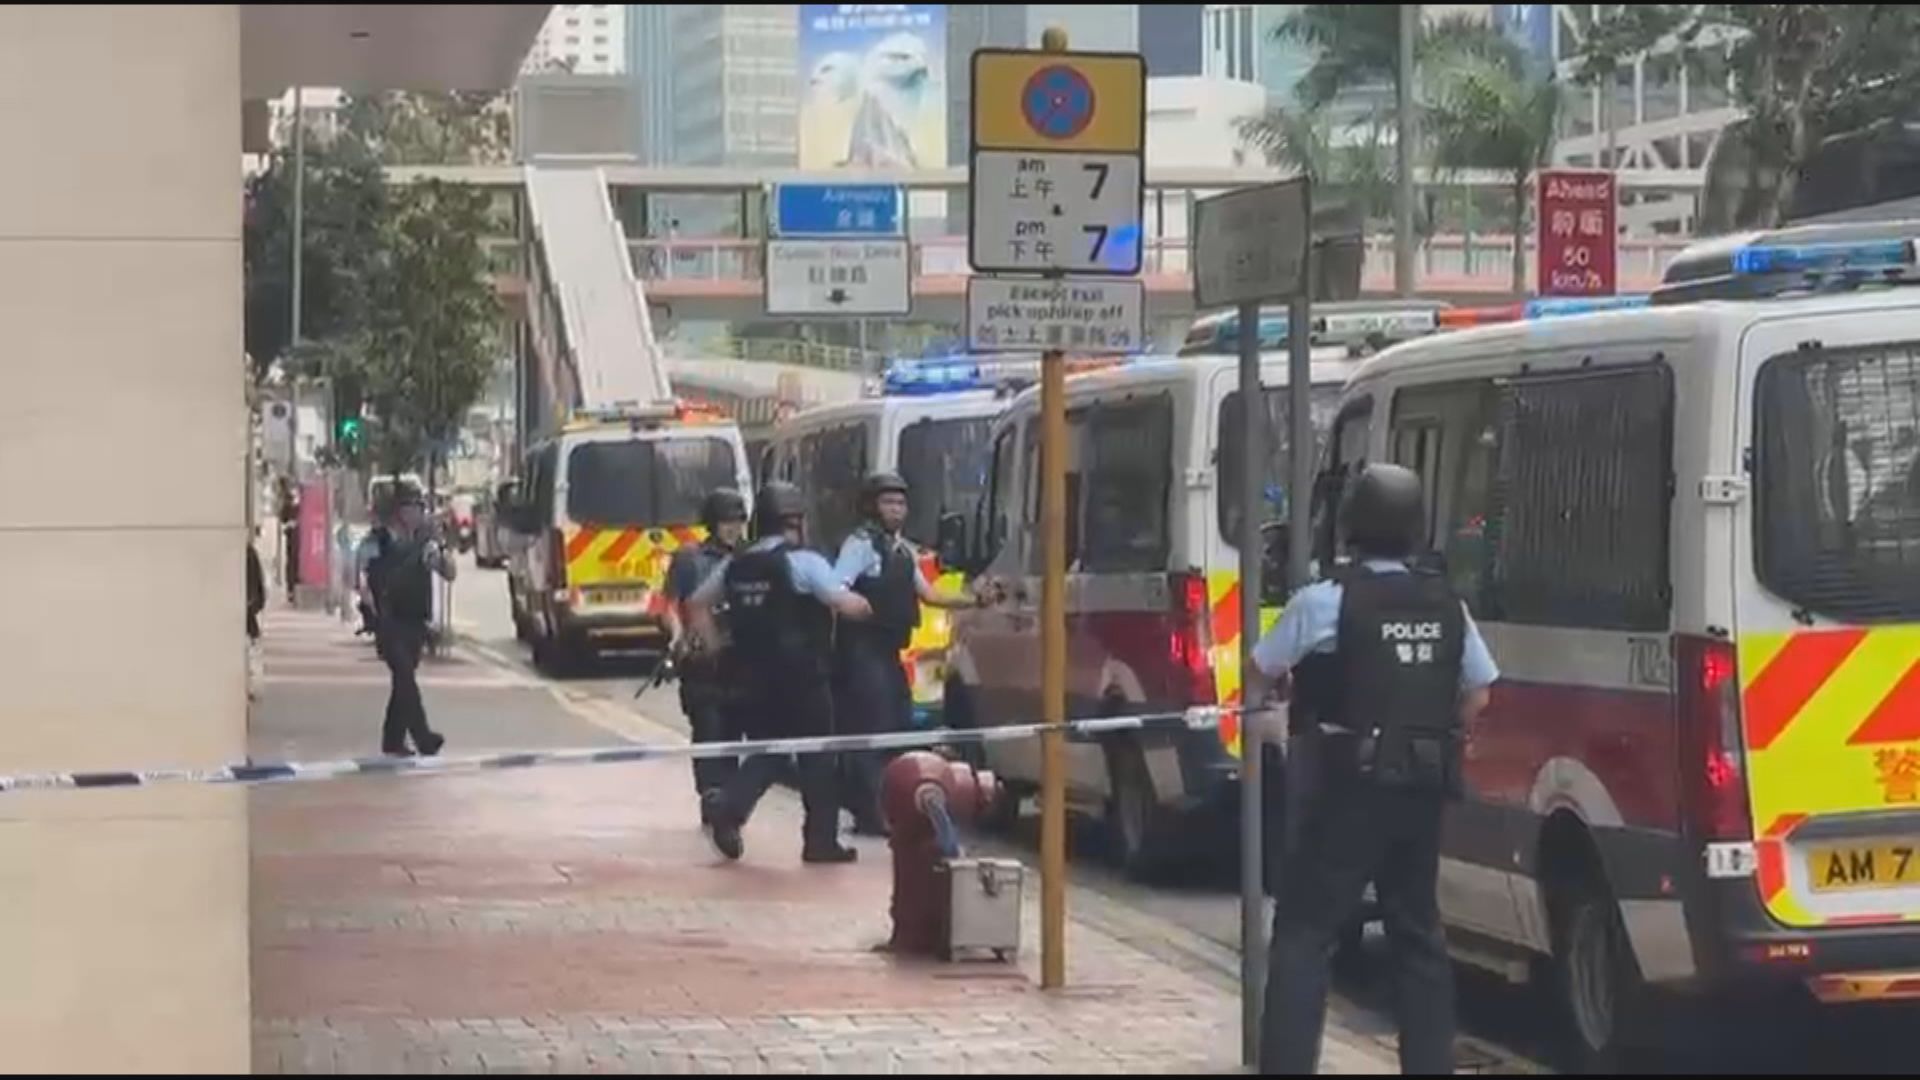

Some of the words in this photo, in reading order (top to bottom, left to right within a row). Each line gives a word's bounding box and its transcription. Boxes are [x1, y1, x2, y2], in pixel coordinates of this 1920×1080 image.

[1017, 158, 1046, 173] am
[1008, 177, 1055, 200] 上午
[1083, 163, 1109, 200] 7
[1016, 220, 1046, 237] pm
[1008, 240, 1055, 263] 下午
[1082, 224, 1109, 263] 7
[987, 303, 1022, 321] pick
[1100, 304, 1124, 318] off
[1381, 622, 1441, 640] POLICE
[1826, 850, 1875, 885] AM
[1892, 848, 1914, 880] 7
